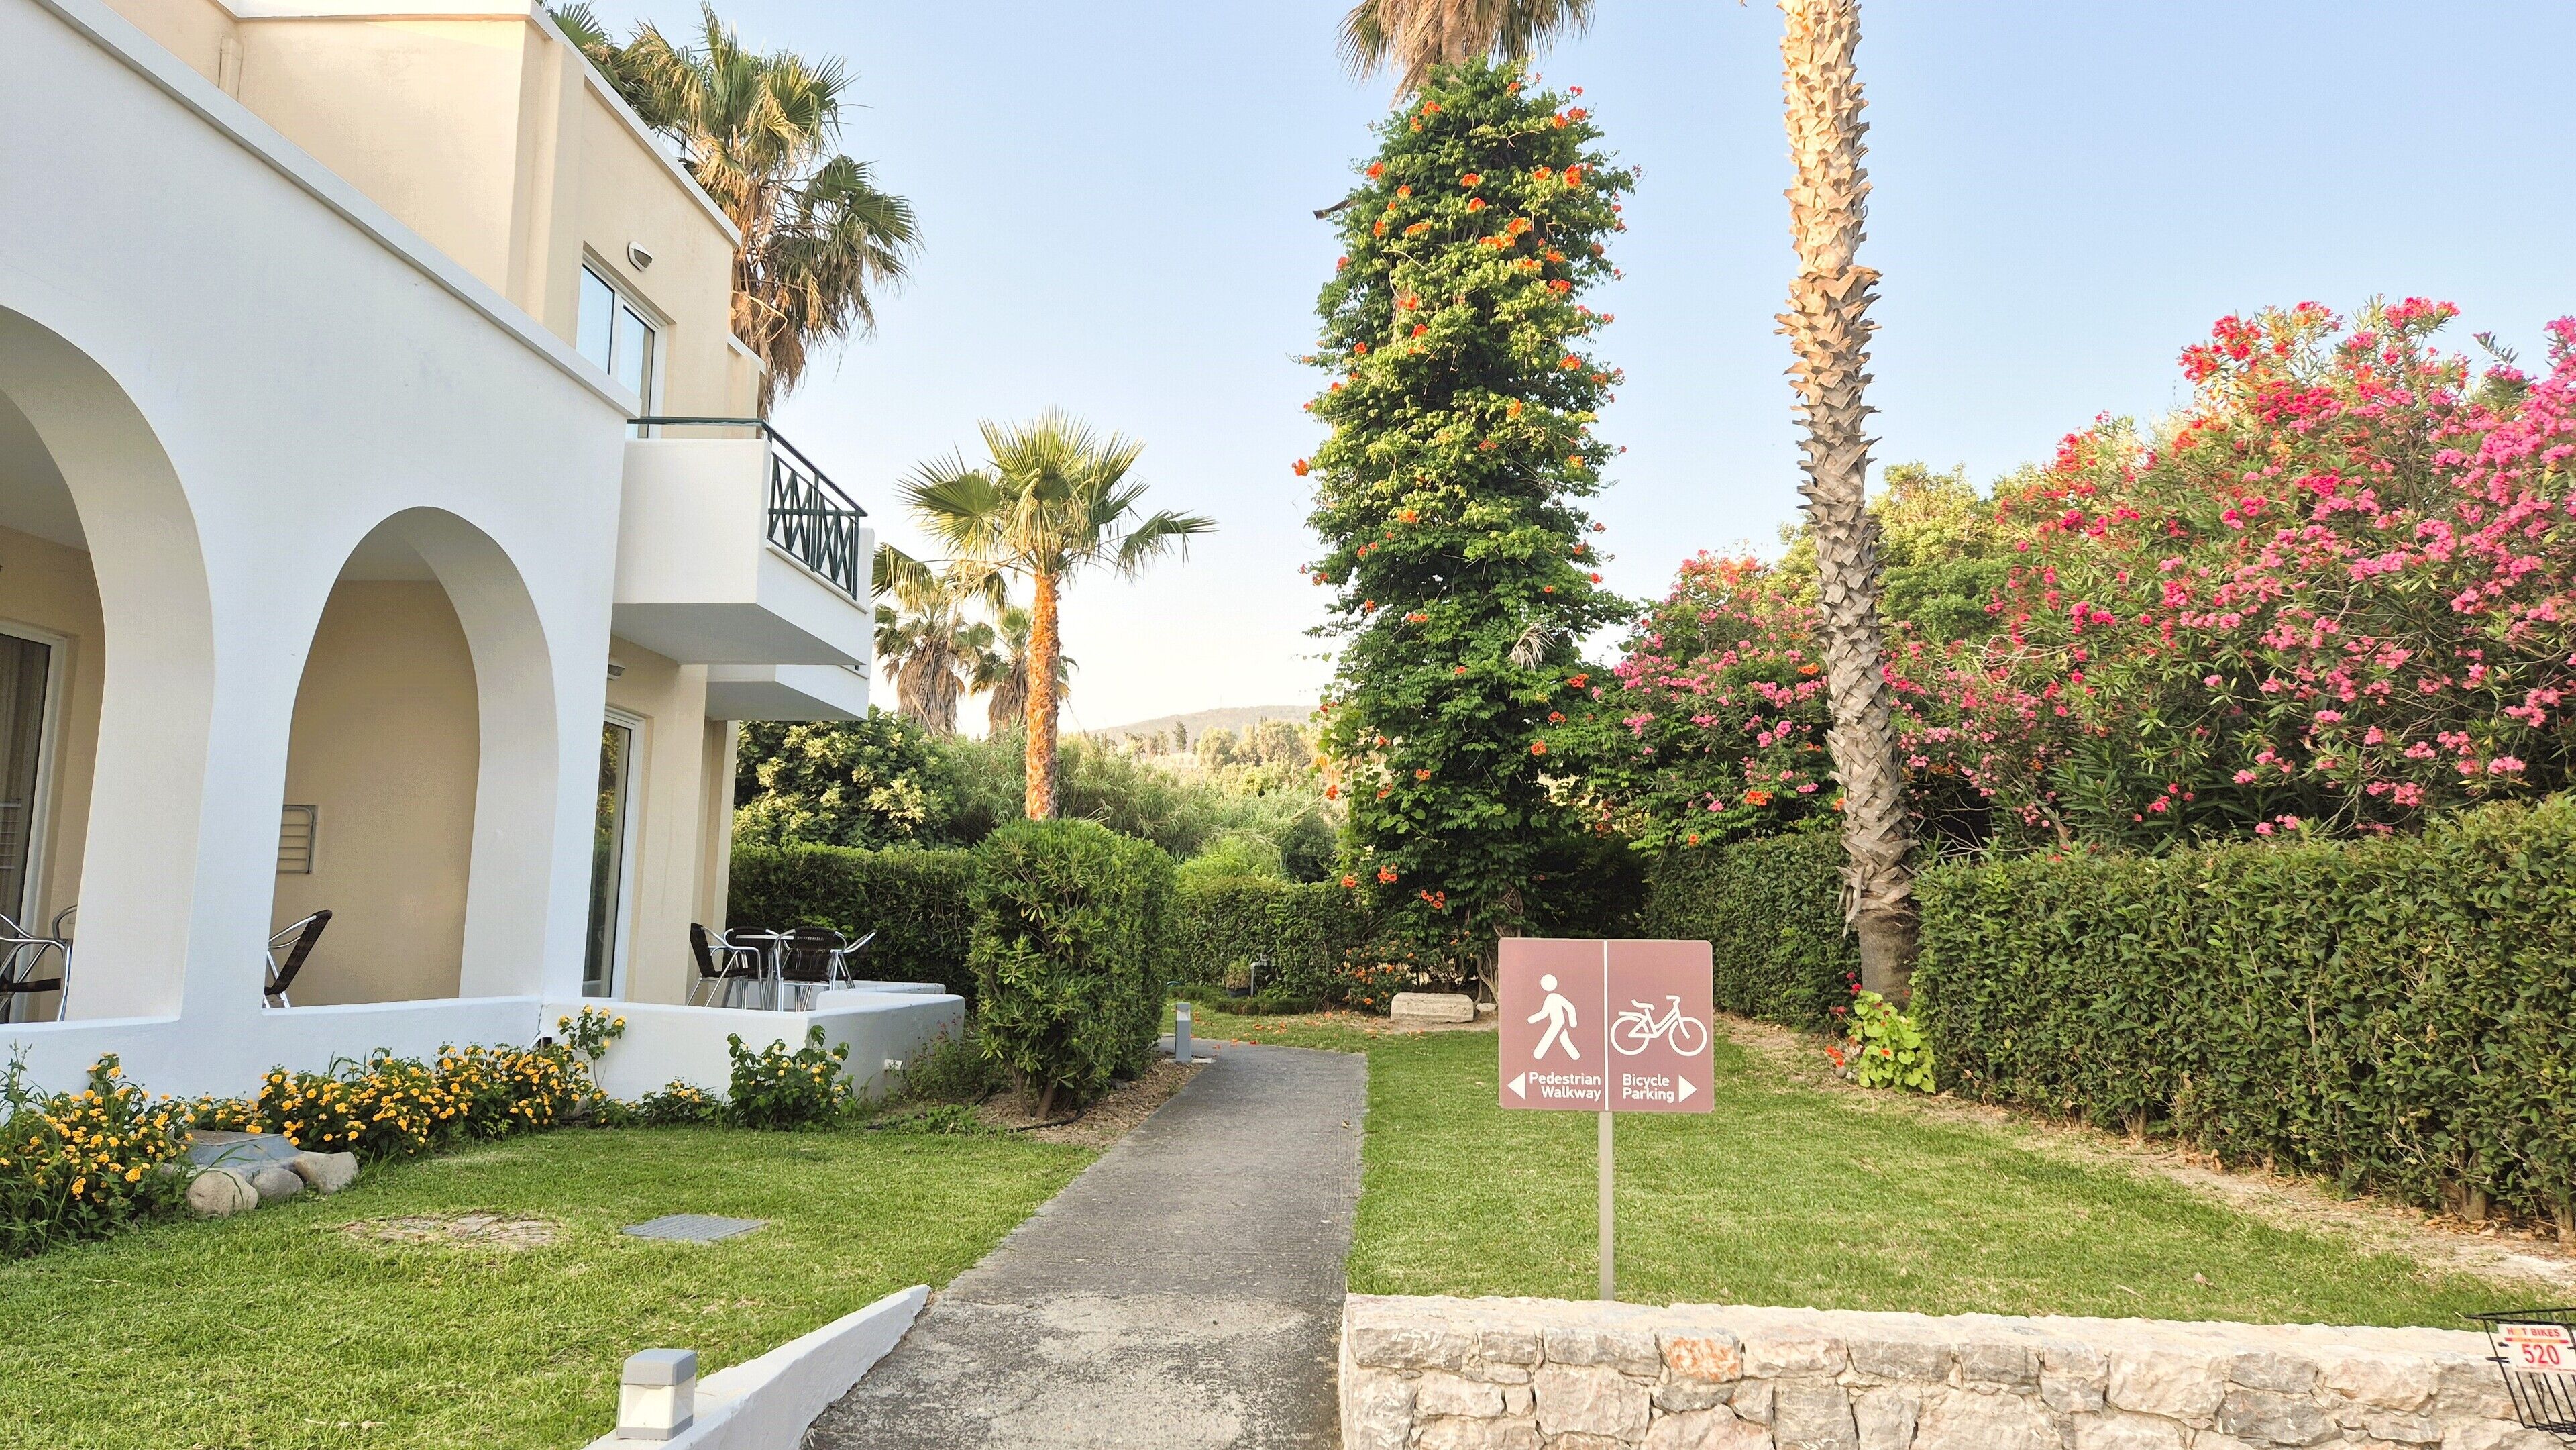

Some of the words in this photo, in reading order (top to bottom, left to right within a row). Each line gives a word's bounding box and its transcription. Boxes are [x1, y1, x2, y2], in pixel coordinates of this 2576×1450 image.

[1529, 1072, 1601, 1085] Pedestrian
[1623, 1073, 1670, 1088] Bicycle
[1541, 1085, 1601, 1102] Walkway
[1623, 1086, 1674, 1103] Parking
[2530, 1328, 2560, 1337] BIKES
[2522, 1343, 2559, 1365] 520
